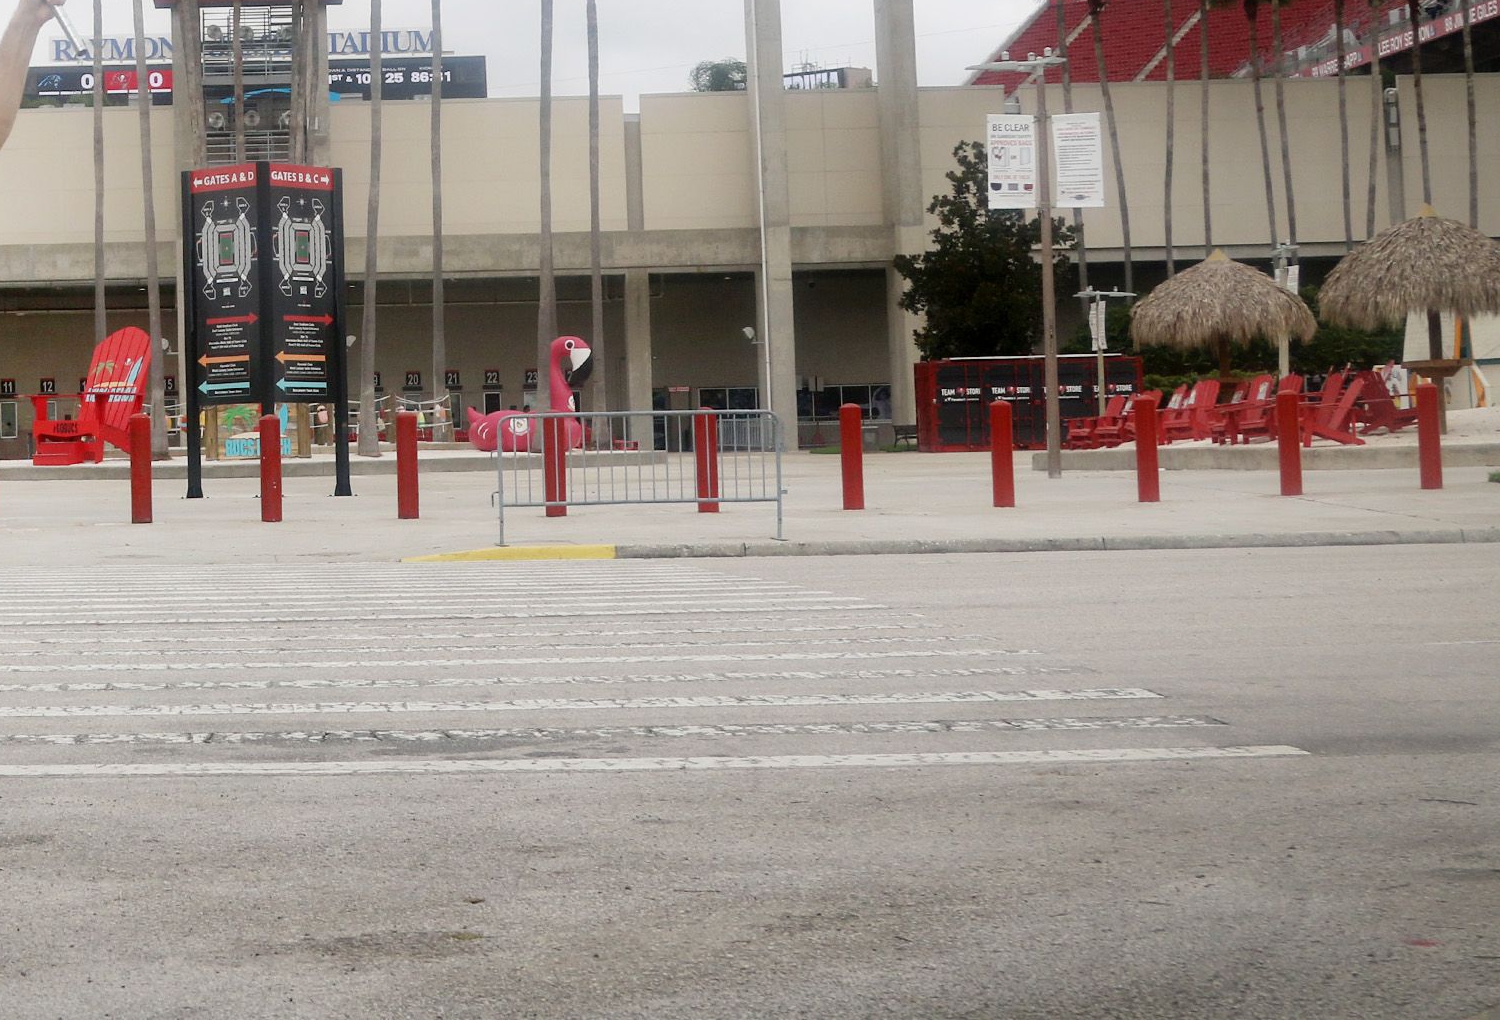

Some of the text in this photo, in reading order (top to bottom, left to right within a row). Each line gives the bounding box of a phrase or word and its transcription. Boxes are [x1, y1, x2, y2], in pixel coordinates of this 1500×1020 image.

[1477, 0, 1498, 20] GILES
[1379, 40, 1391, 56] LEE
[81, 74, 94, 89] 0
[150, 72, 163, 87] 0
[346, 75, 353, 83] &
[356, 73, 371, 85] 10
[385, 72, 404, 84] 25
[411, 71, 451, 83] 86:1
[992, 124, 1030, 132] BE CLEAR
[204, 171, 254, 186] GATES A & D
[271, 170, 319, 184] GATES B & C
[408, 374, 419, 385] 20
[448, 373, 457, 384] 21
[487, 372, 498, 383] 22
[527, 372, 538, 383] 23
[3, 382, 13, 392] 11
[43, 381, 53, 392] 12
